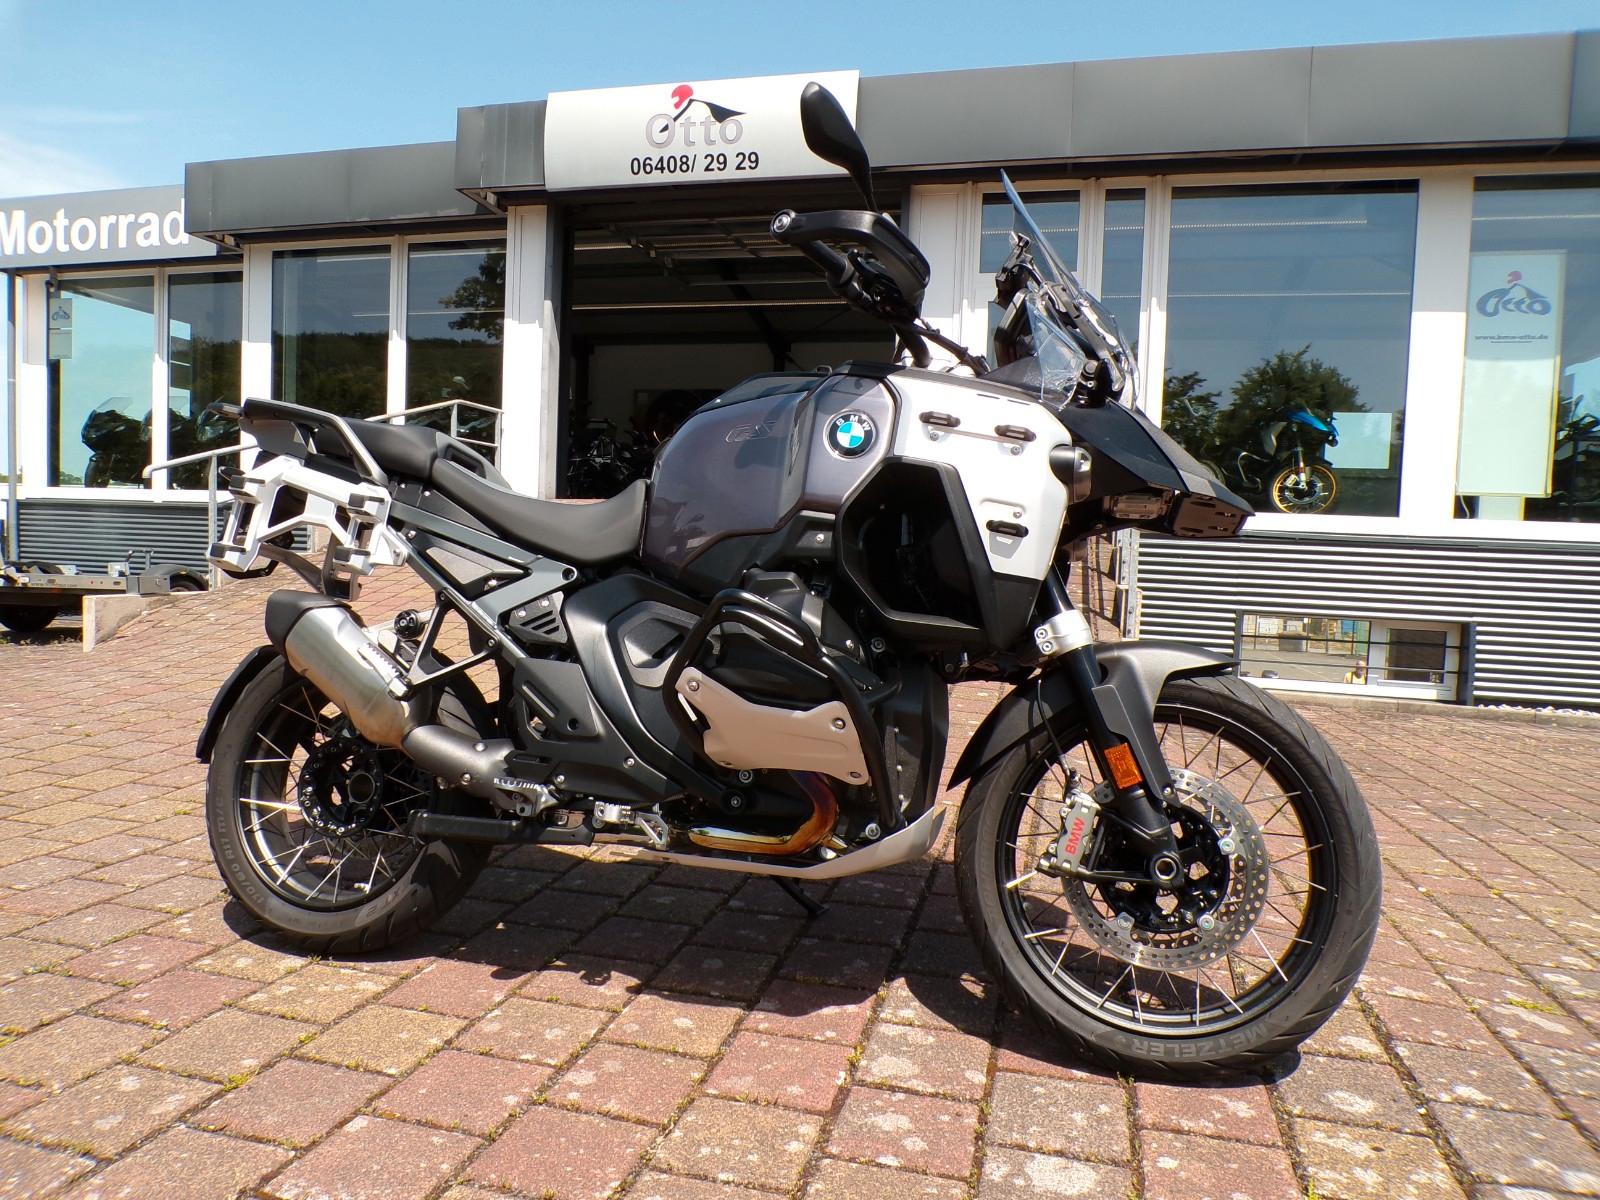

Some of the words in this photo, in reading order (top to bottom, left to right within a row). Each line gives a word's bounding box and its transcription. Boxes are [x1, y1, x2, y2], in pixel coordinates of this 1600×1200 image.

[645, 113, 743, 149] Otto
[630, 154, 697, 175] 06408/
[703, 153, 728, 172] 29
[735, 151, 759, 171] 29
[0, 197, 190, 256] Motorrad
[835, 414, 871, 431] BMW
[1065, 816, 1085, 855] BMW
[1128, 1022, 1268, 1059] METZELER
